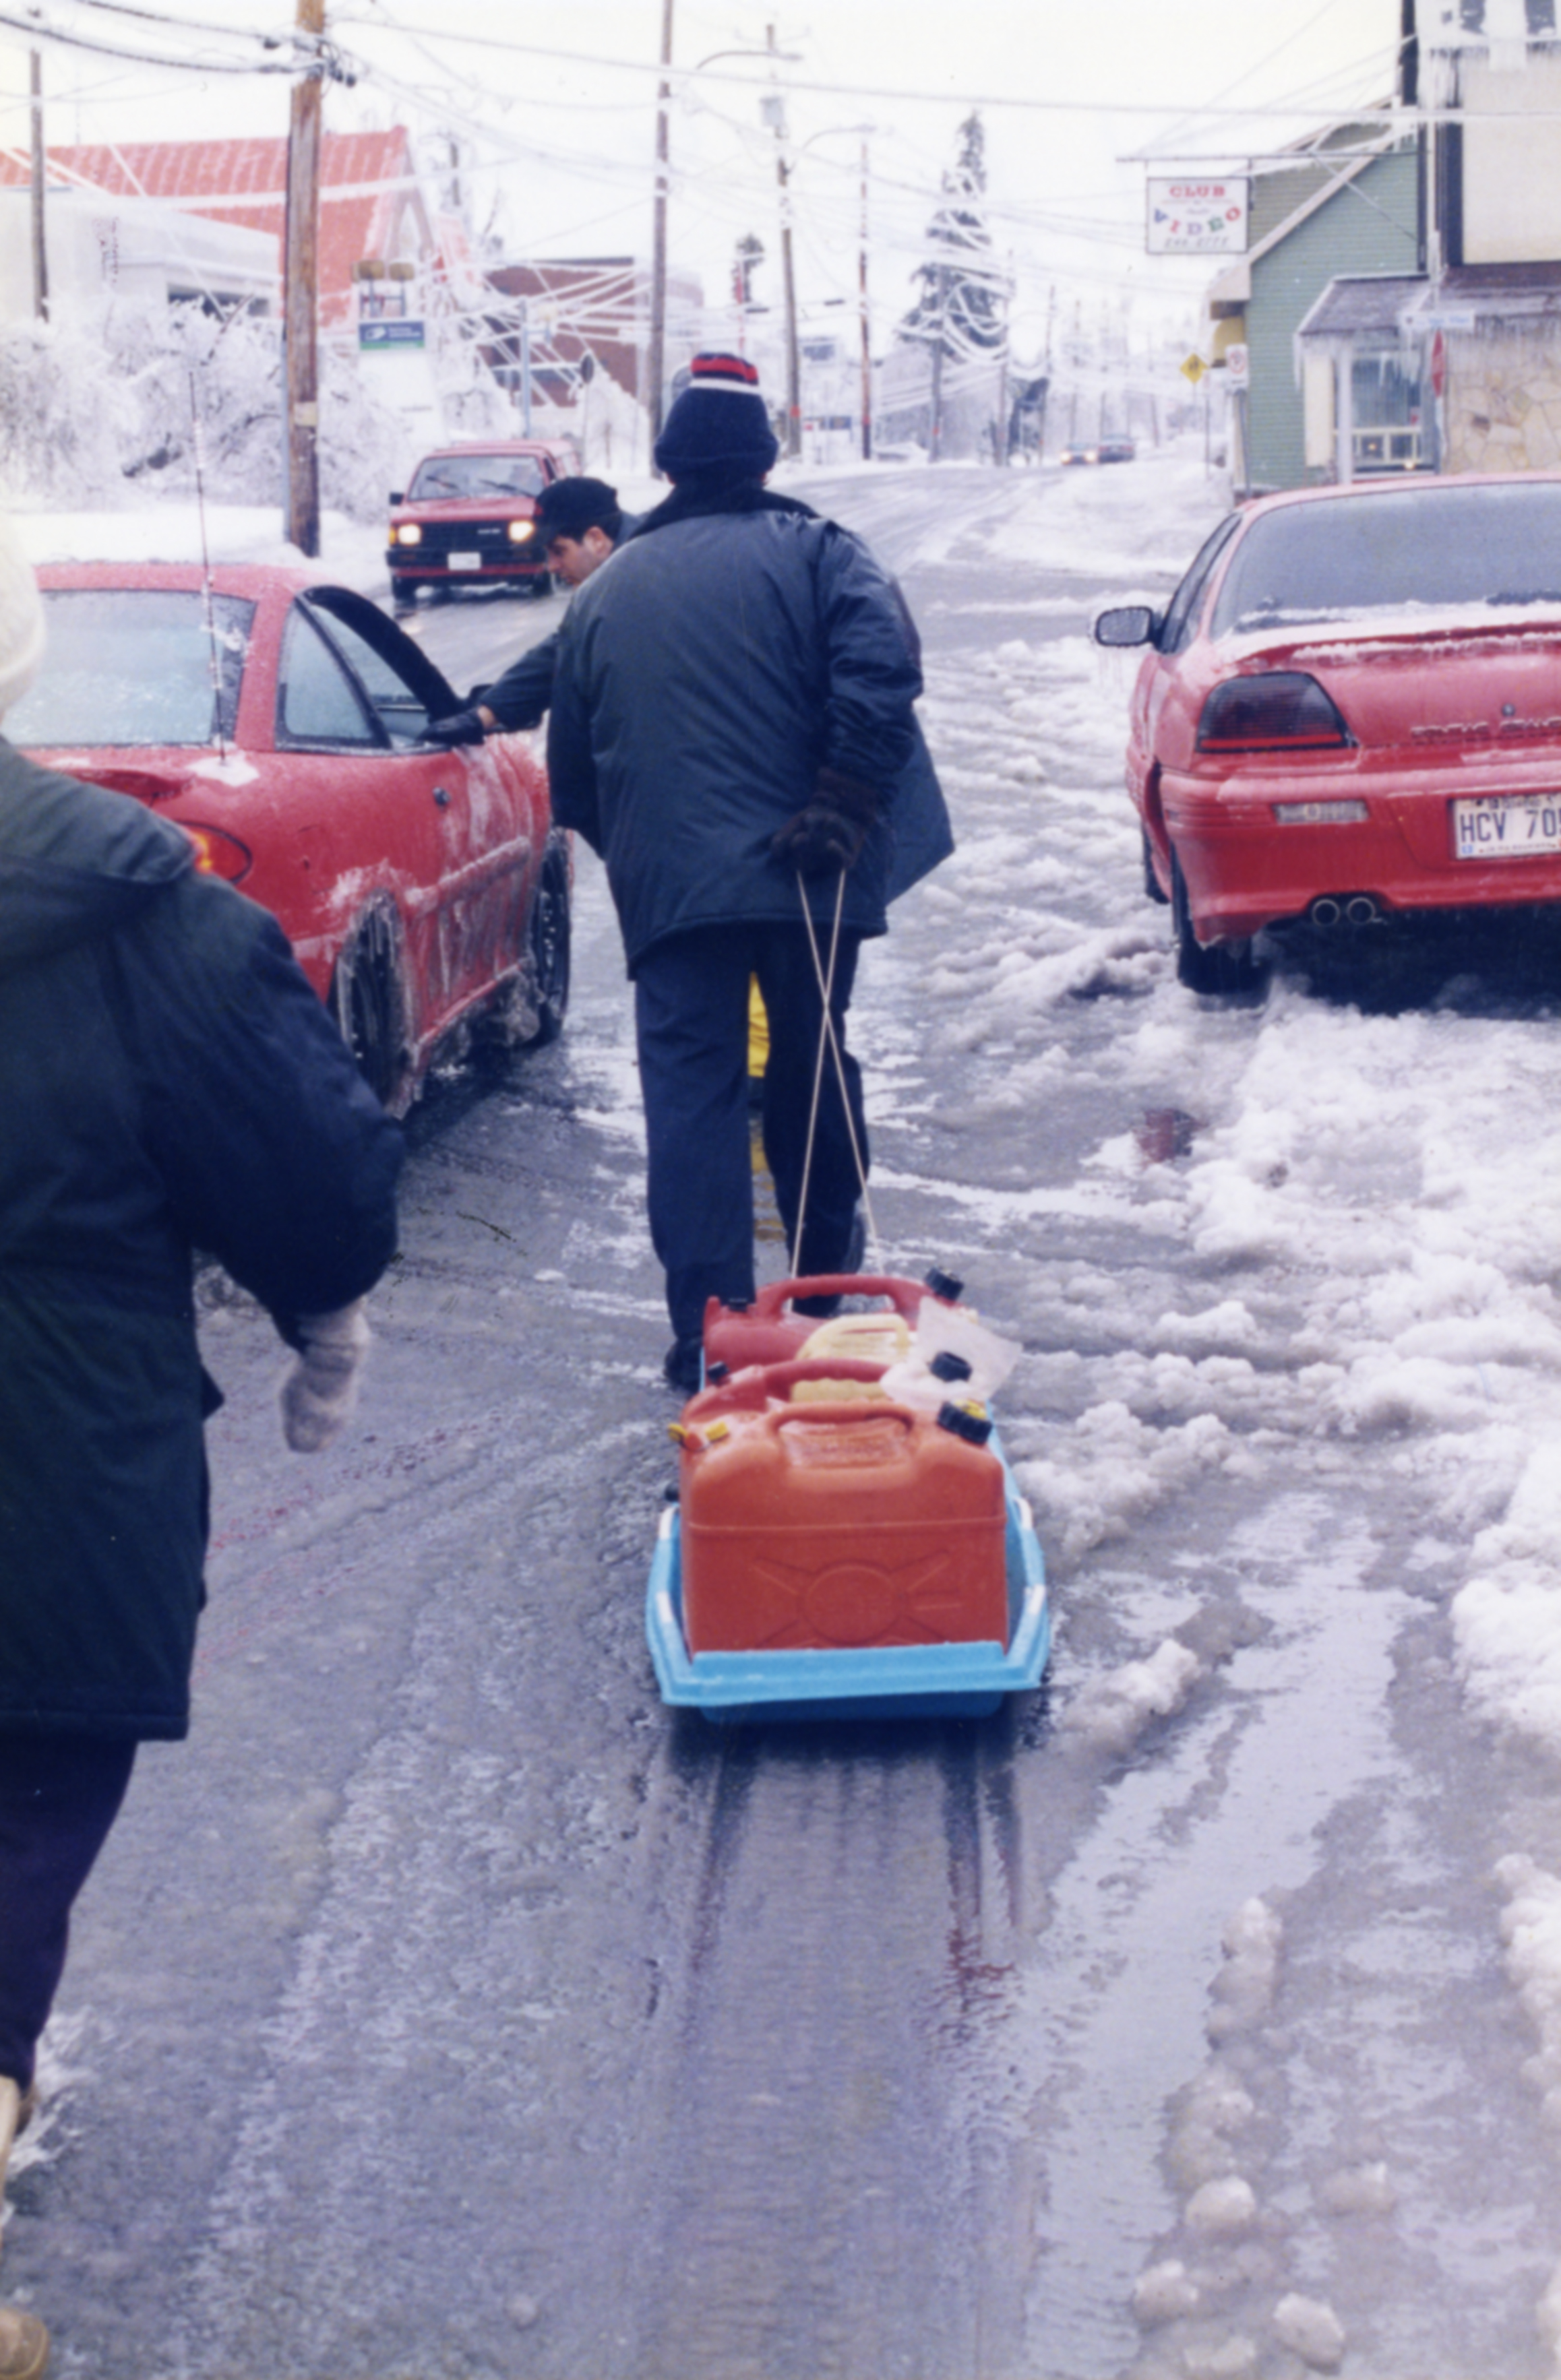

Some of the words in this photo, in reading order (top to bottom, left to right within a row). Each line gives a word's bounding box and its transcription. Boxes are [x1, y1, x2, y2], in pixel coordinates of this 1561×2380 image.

[1169, 186, 1225, 197] CLUB
[1154, 207, 1242, 235] VIDEO
[1460, 811, 1506, 843] HCV
[1525, 807, 1561, 839] 70
